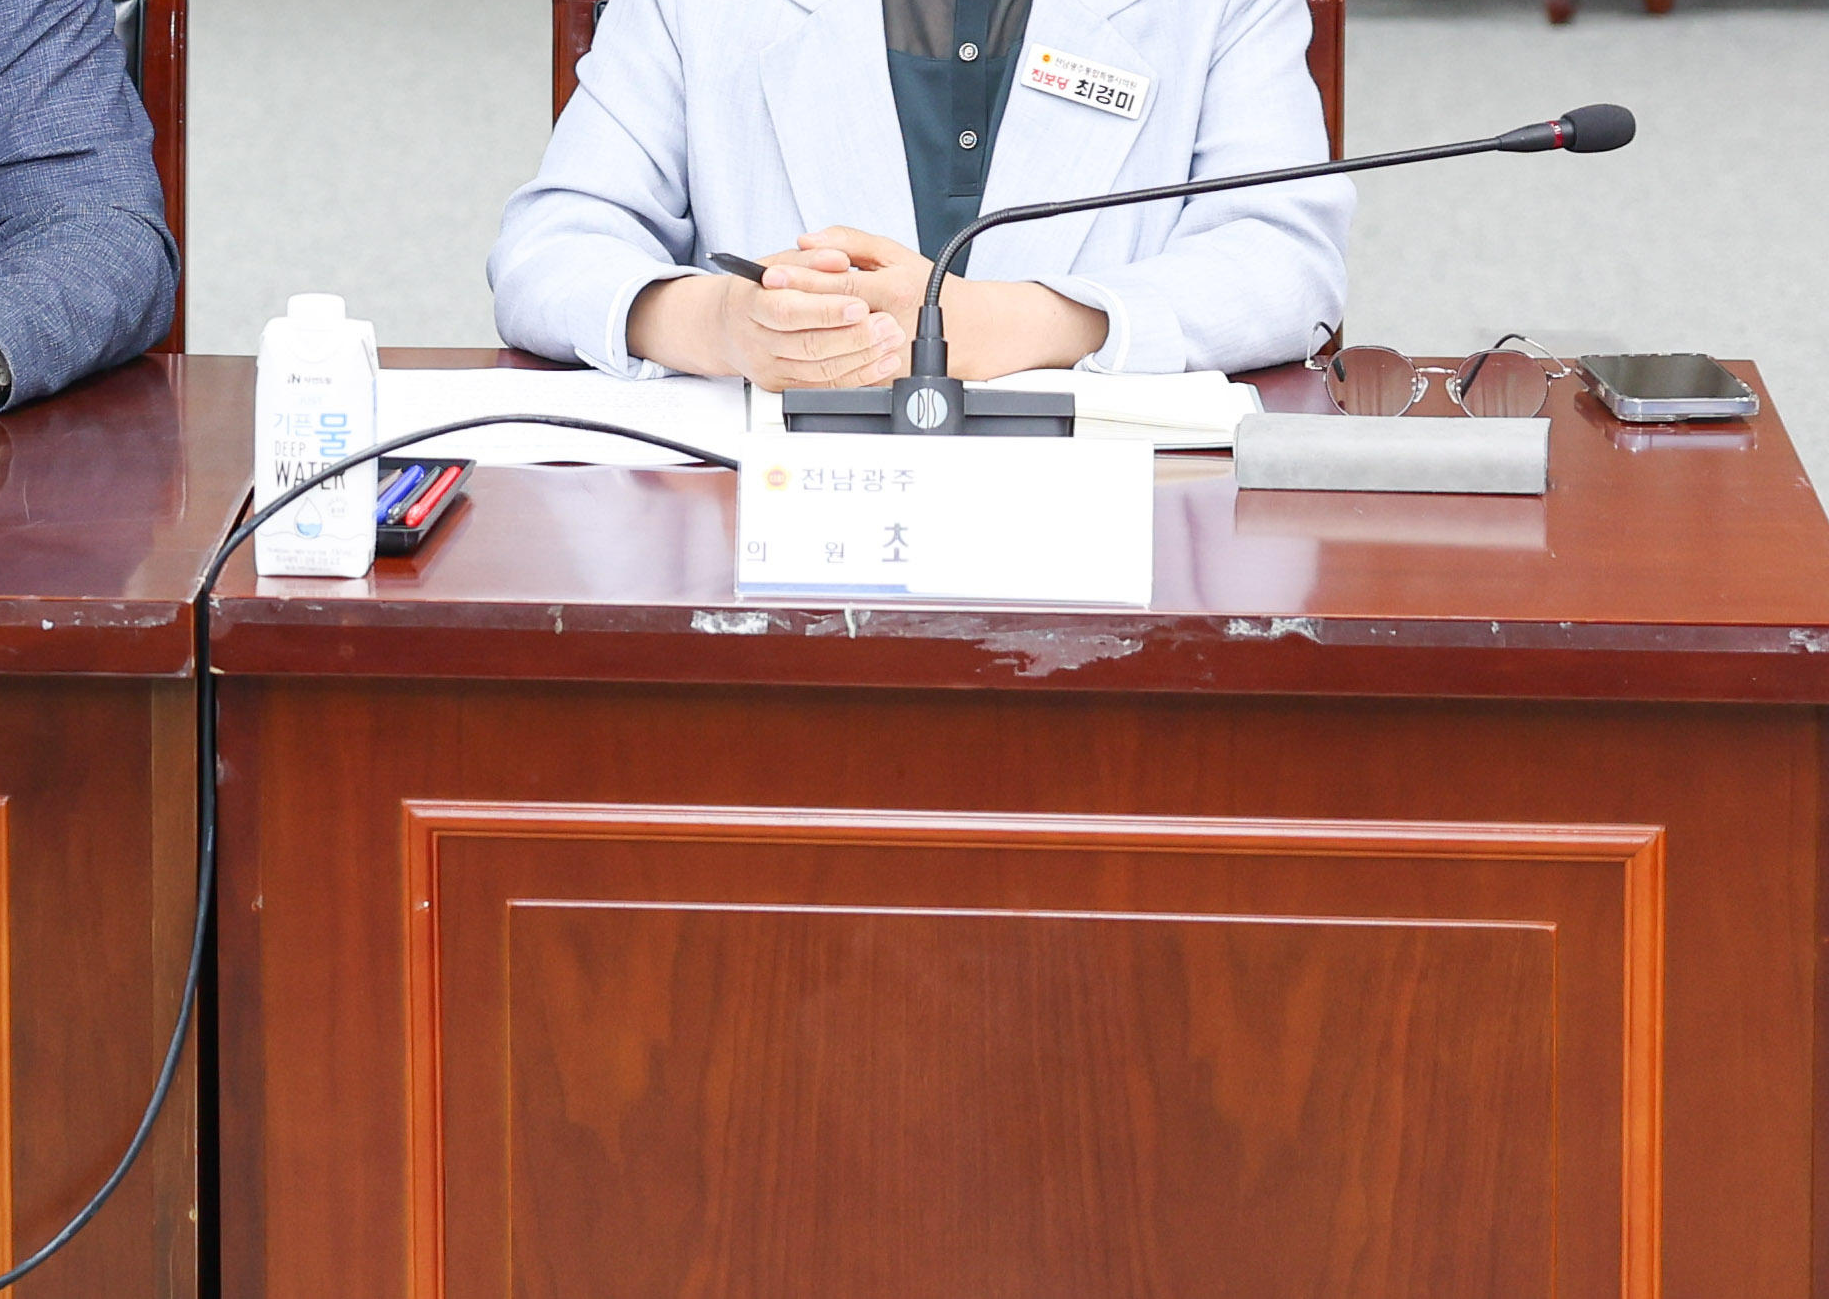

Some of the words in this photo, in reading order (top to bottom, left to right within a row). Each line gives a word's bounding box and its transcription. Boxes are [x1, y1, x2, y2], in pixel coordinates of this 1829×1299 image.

[1031, 68, 1070, 90] 진보당
[1074, 79, 1135, 112] 최경미
[273, 413, 313, 436] 기픈
[314, 413, 351, 457] 물
[275, 441, 306, 456] DEEP
